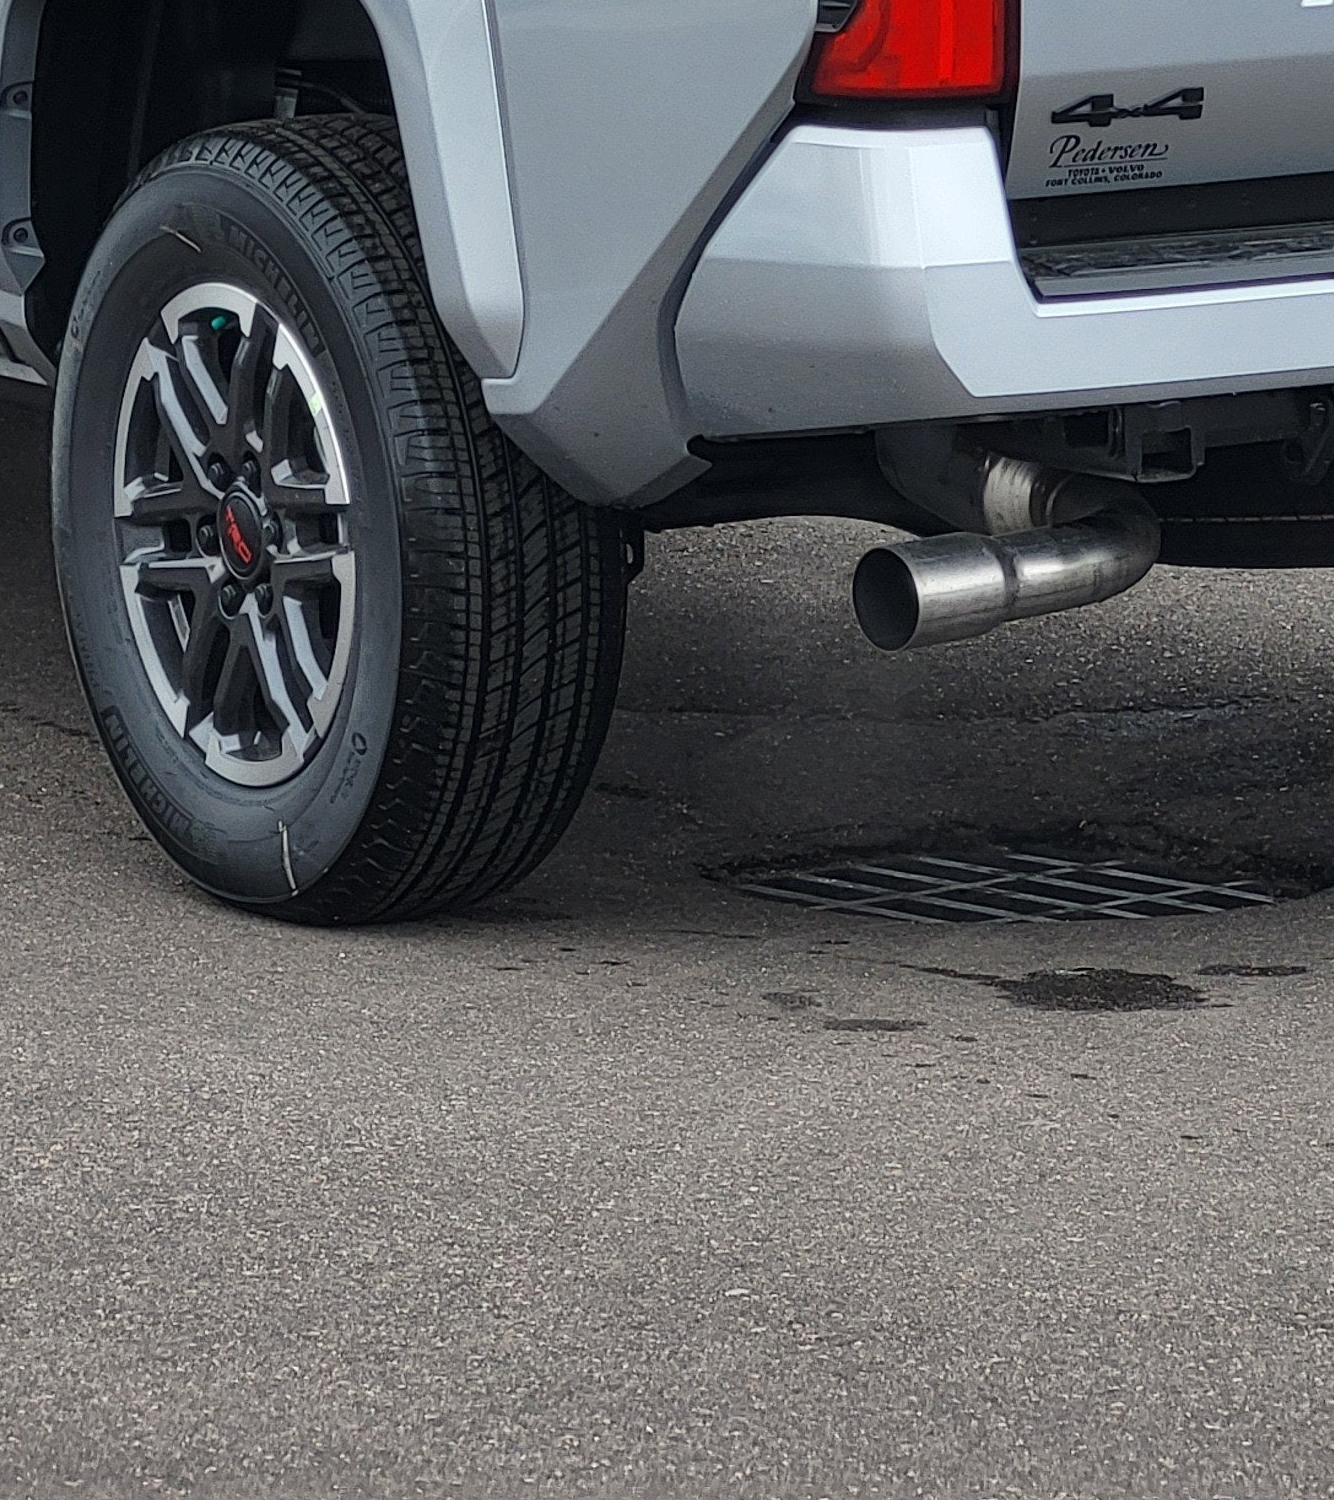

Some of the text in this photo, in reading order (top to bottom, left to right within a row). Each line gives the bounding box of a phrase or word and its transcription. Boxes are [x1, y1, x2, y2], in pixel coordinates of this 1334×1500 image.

[1049, 134, 1169, 168] Pedersen
[1108, 164, 1145, 175] VOLVO
[225, 504, 253, 565] TRD
